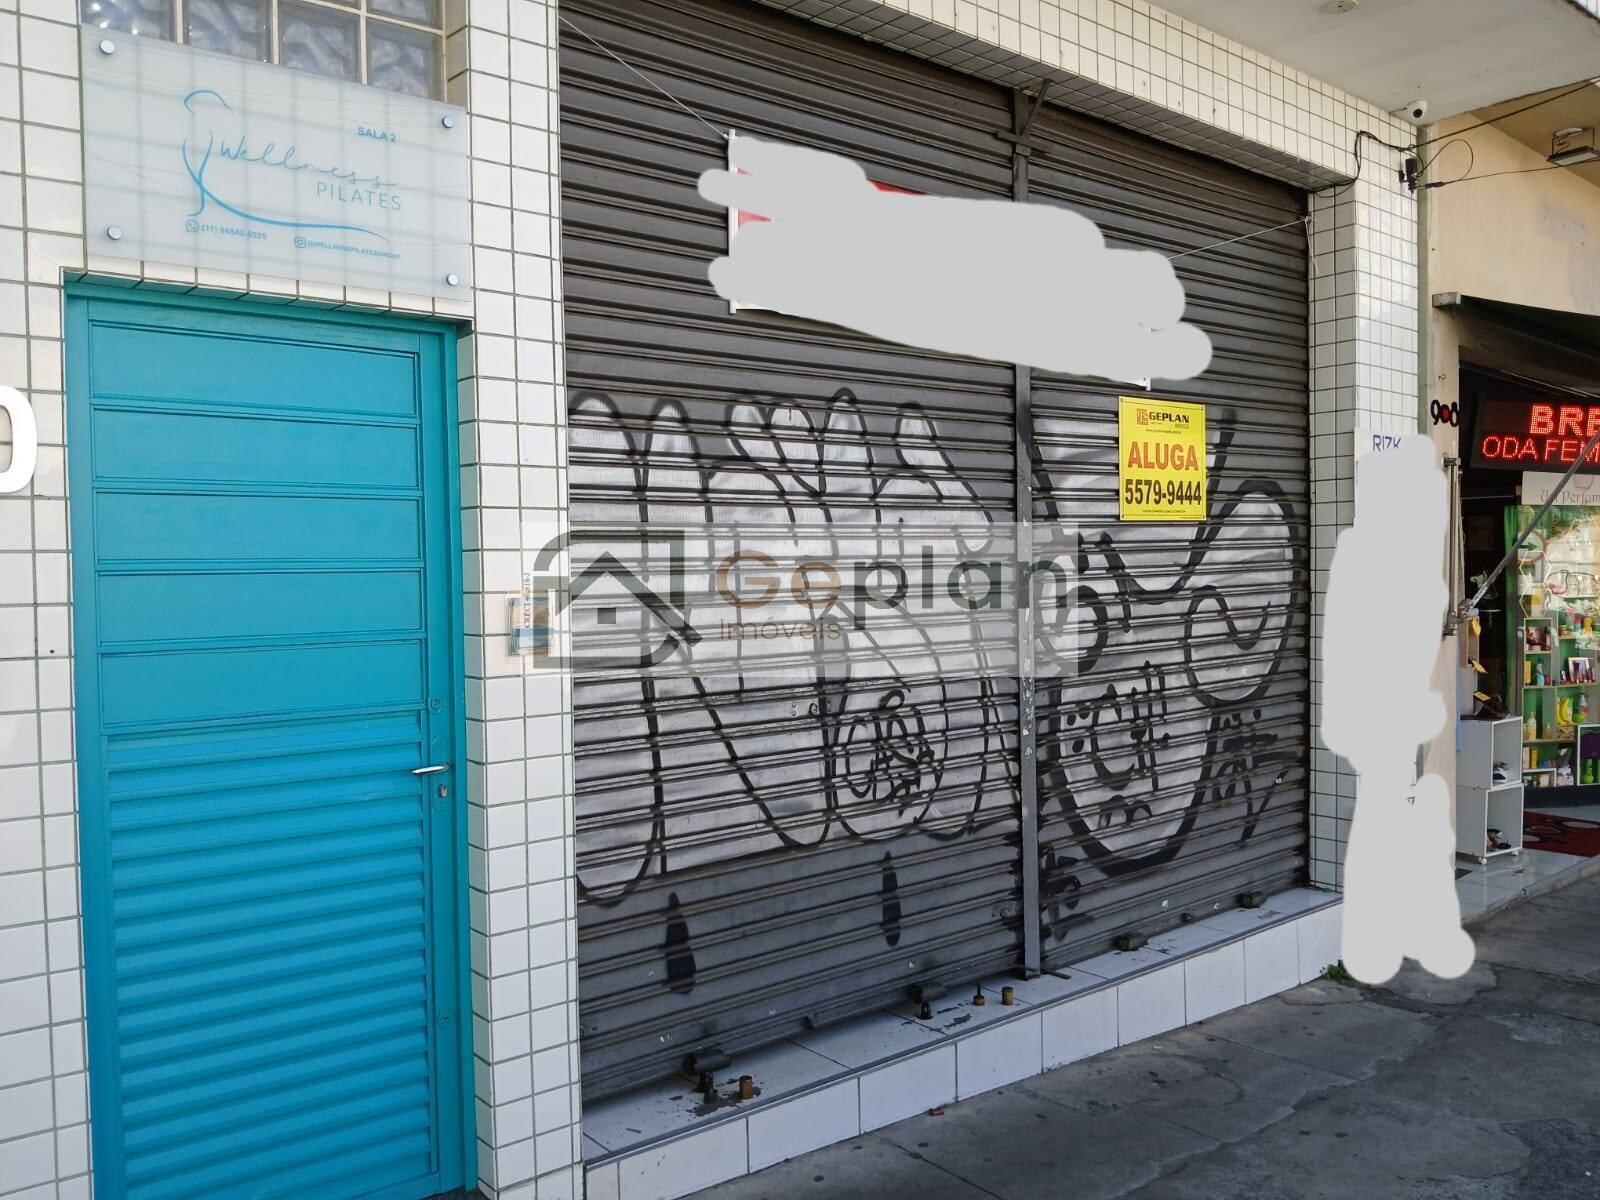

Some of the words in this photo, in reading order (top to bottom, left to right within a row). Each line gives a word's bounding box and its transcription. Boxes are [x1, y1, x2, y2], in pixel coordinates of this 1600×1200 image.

[357, 126, 387, 140] SALA
[389, 133, 398, 143] 2
[220, 136, 400, 188] Wellness
[316, 182, 401, 211] PILATES
[1149, 411, 1190, 423] GEPLAN
[1127, 441, 1199, 471] ALUGA
[1483, 436, 1538, 459] ODA
[1125, 478, 1202, 505] 5579-9444
